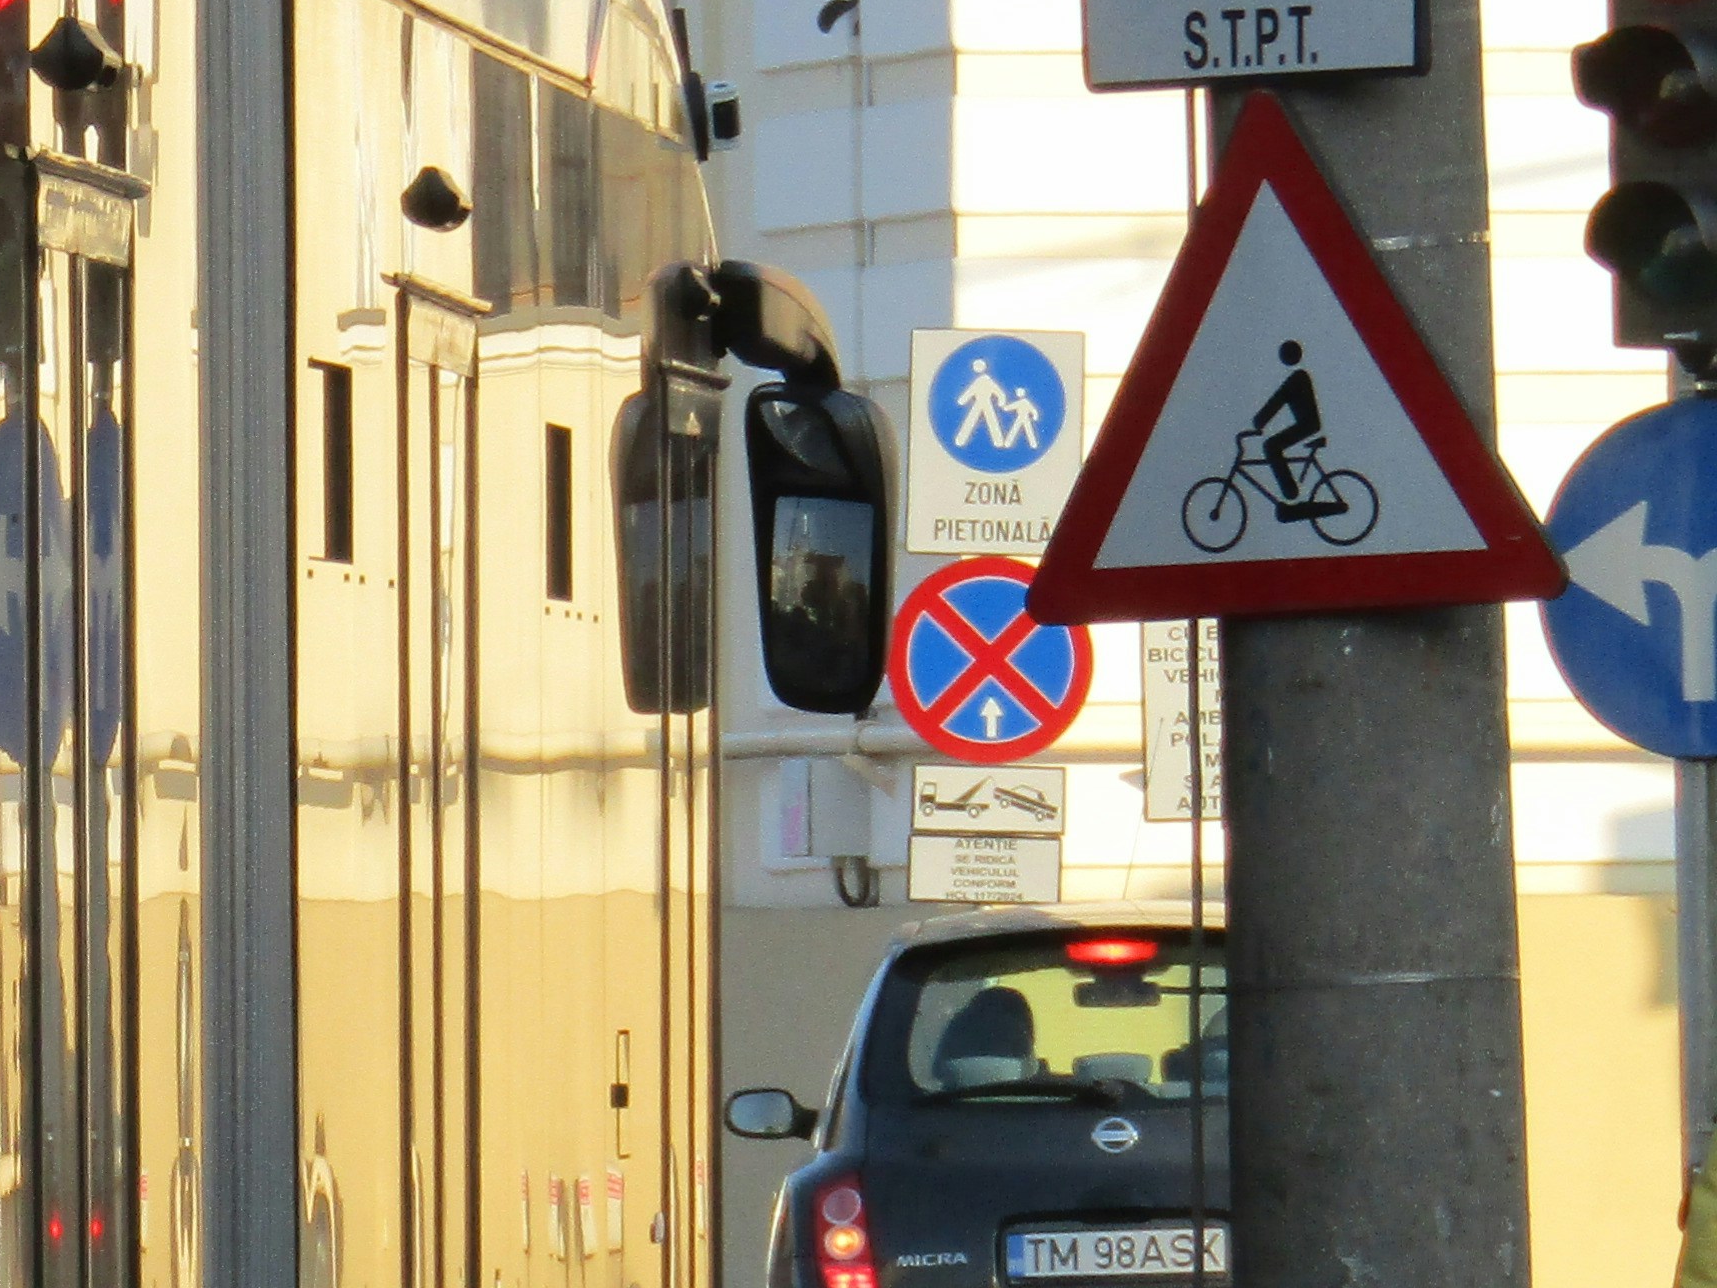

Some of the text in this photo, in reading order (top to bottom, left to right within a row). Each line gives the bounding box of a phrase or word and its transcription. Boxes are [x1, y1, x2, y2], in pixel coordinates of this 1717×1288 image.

[1183, 5, 1318, 70] S.T.P.T.
[964, 478, 1023, 505] ZONĂ
[934, 516, 1053, 543] PIETONALĂ
[896, 1251, 968, 1267] MICRA
[1027, 1237, 1080, 1272] TM
